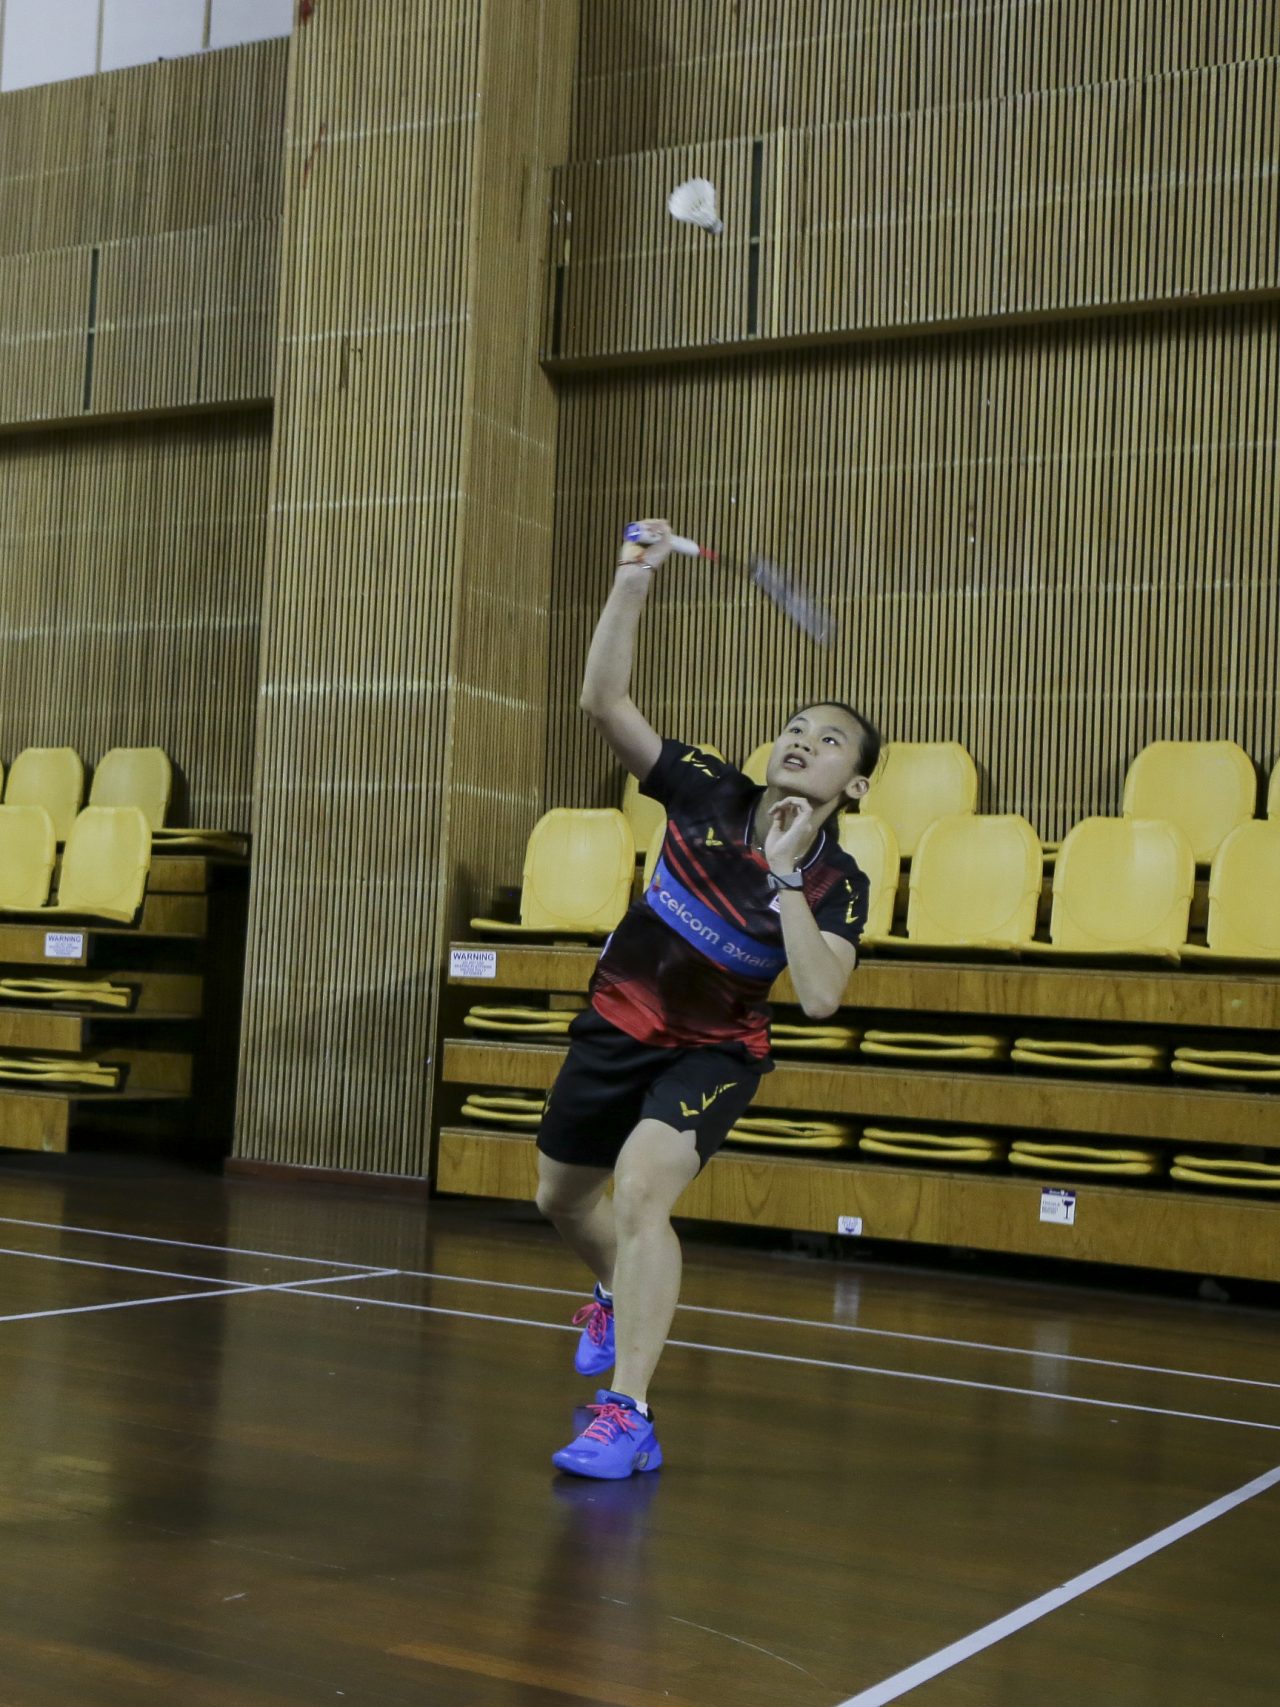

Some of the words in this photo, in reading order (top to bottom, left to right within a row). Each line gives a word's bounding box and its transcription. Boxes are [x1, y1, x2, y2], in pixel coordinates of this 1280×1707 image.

[659, 890, 721, 945] celcom
[48, 935, 81, 943] WARNING
[453, 951, 495, 961] WARNING
